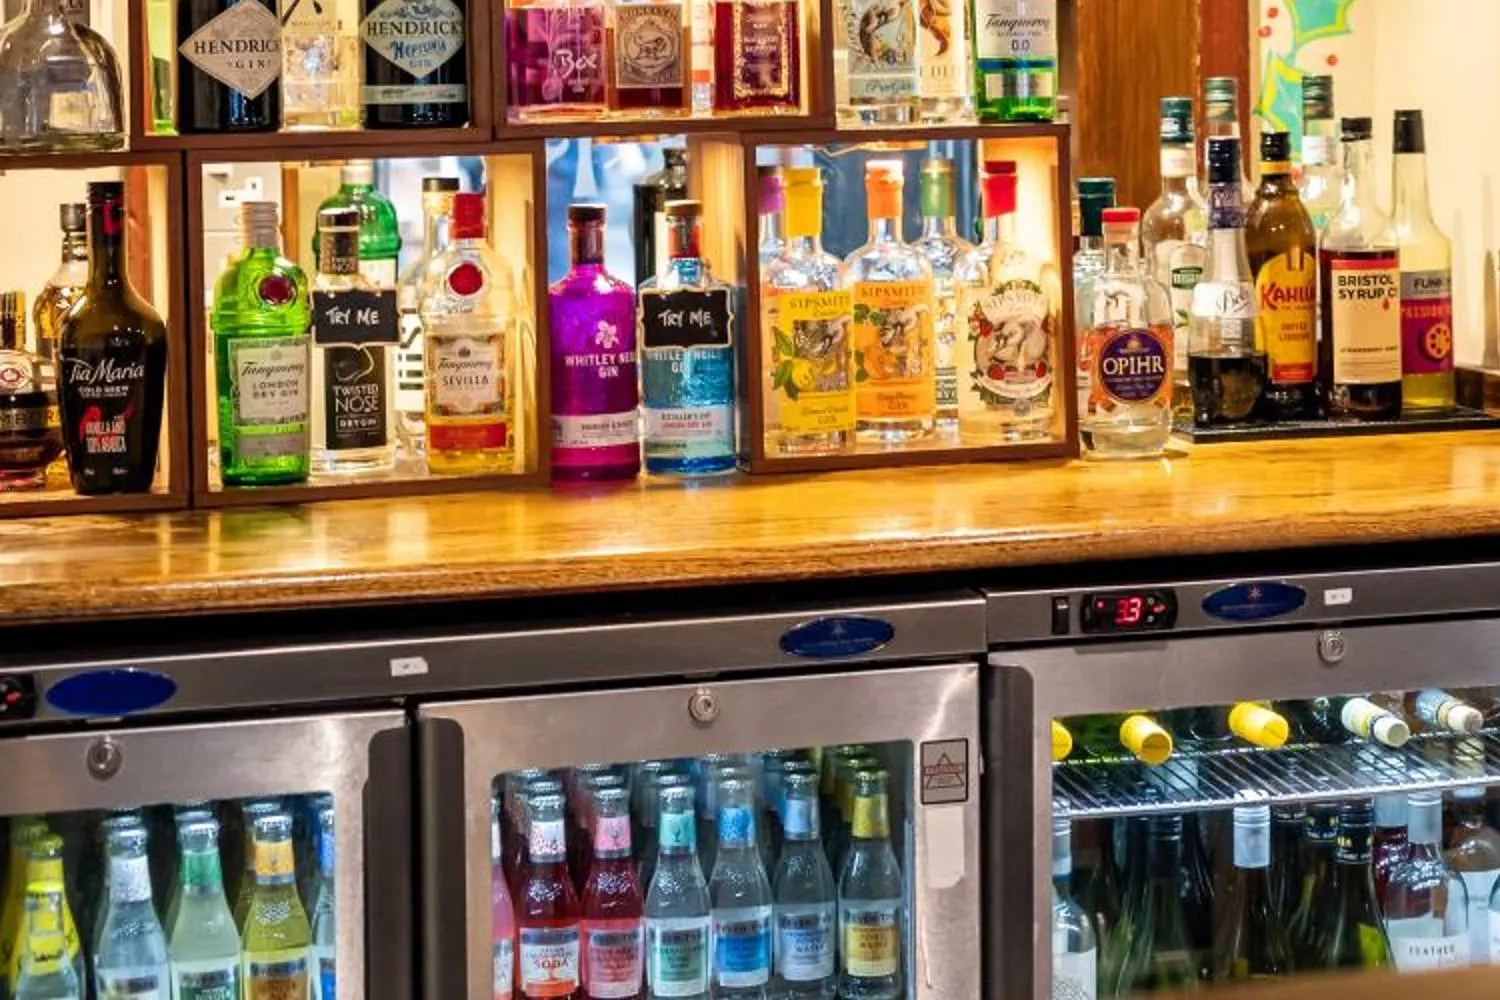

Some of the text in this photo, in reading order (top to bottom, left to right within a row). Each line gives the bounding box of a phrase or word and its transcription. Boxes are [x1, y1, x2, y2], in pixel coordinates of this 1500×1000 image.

[1337, 274, 1394, 288] BRISTOL
[1337, 289, 1385, 300] SYRUP
[325, 306, 380, 326] TRY ME
[657, 308, 712, 328] TRY ME
[565, 353, 616, 367] WHITLEY
[1103, 355, 1164, 376] OPIHR
[66, 357, 144, 383] Tia Maria
[598, 365, 619, 378] GIN
[442, 375, 489, 386] SEVILLA
[335, 395, 380, 413] NOSE
[534, 956, 569, 969] SODA
